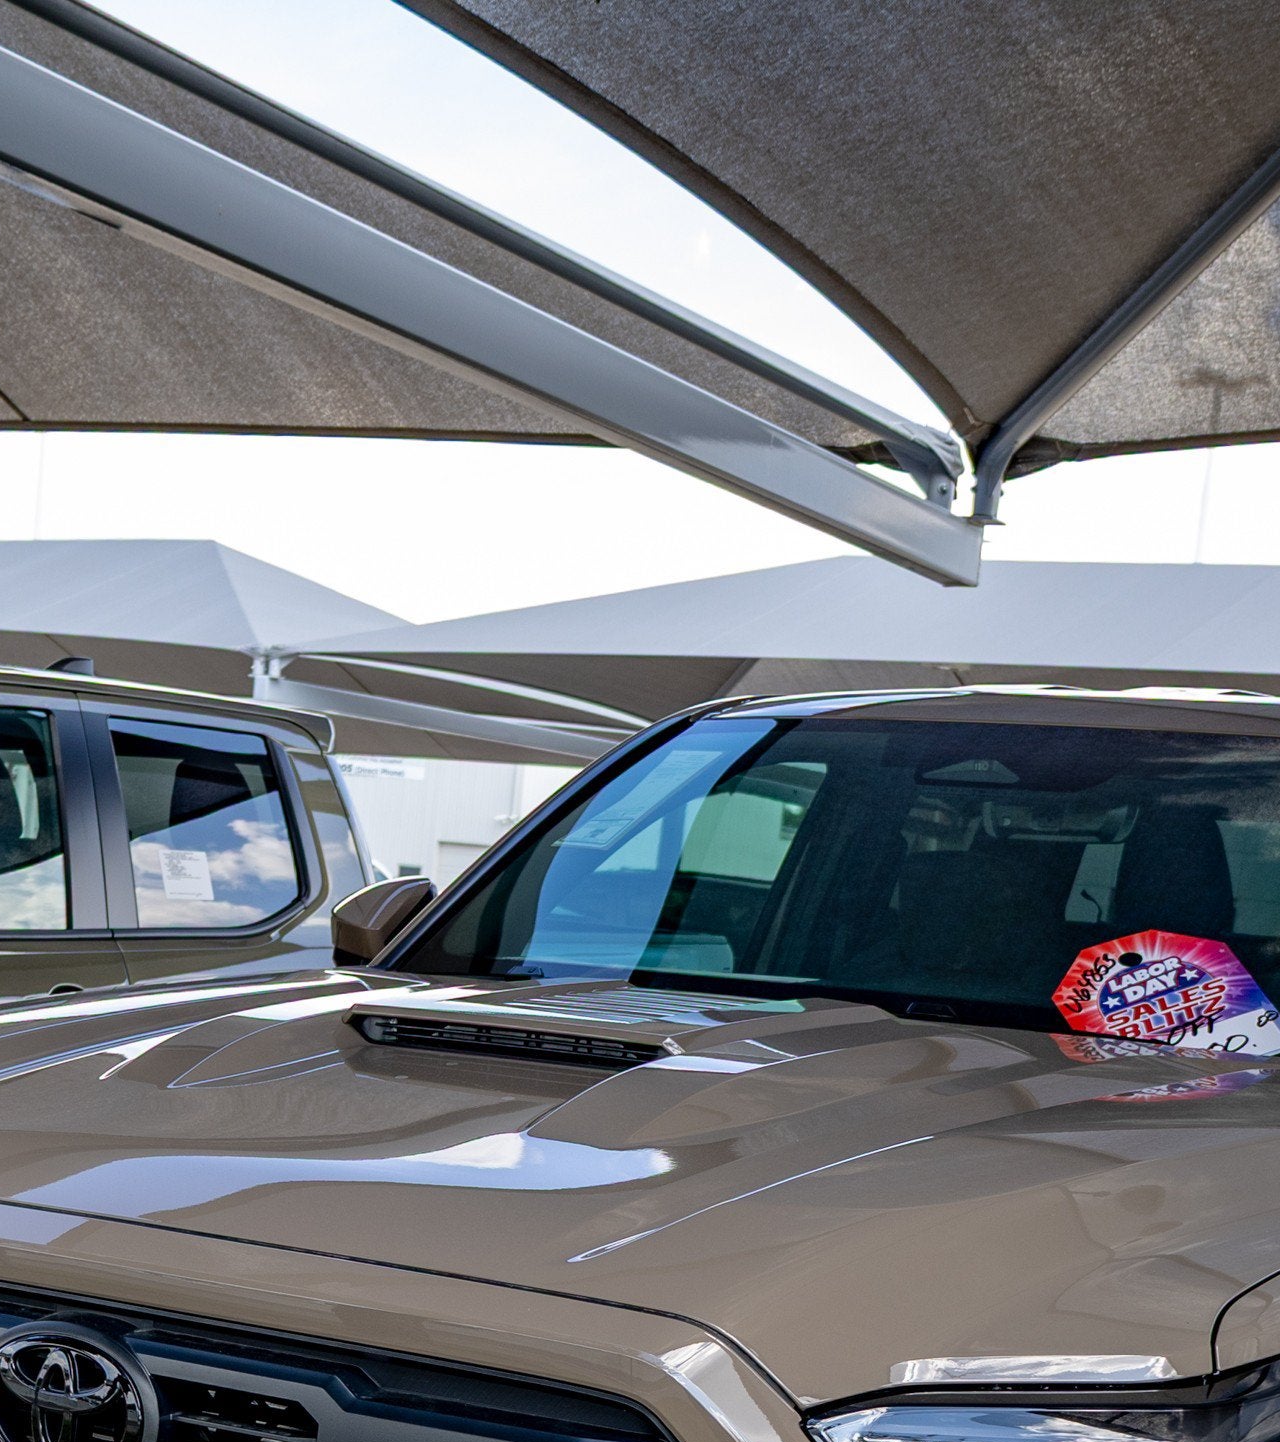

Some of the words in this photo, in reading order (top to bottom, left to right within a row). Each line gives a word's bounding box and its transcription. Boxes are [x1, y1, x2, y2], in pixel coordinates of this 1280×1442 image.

[1107, 957, 1184, 993] LABOR
[1123, 972, 1179, 1004] DAY
[1105, 978, 1227, 1026] SALES
[1118, 995, 1226, 1038] BLITZ
